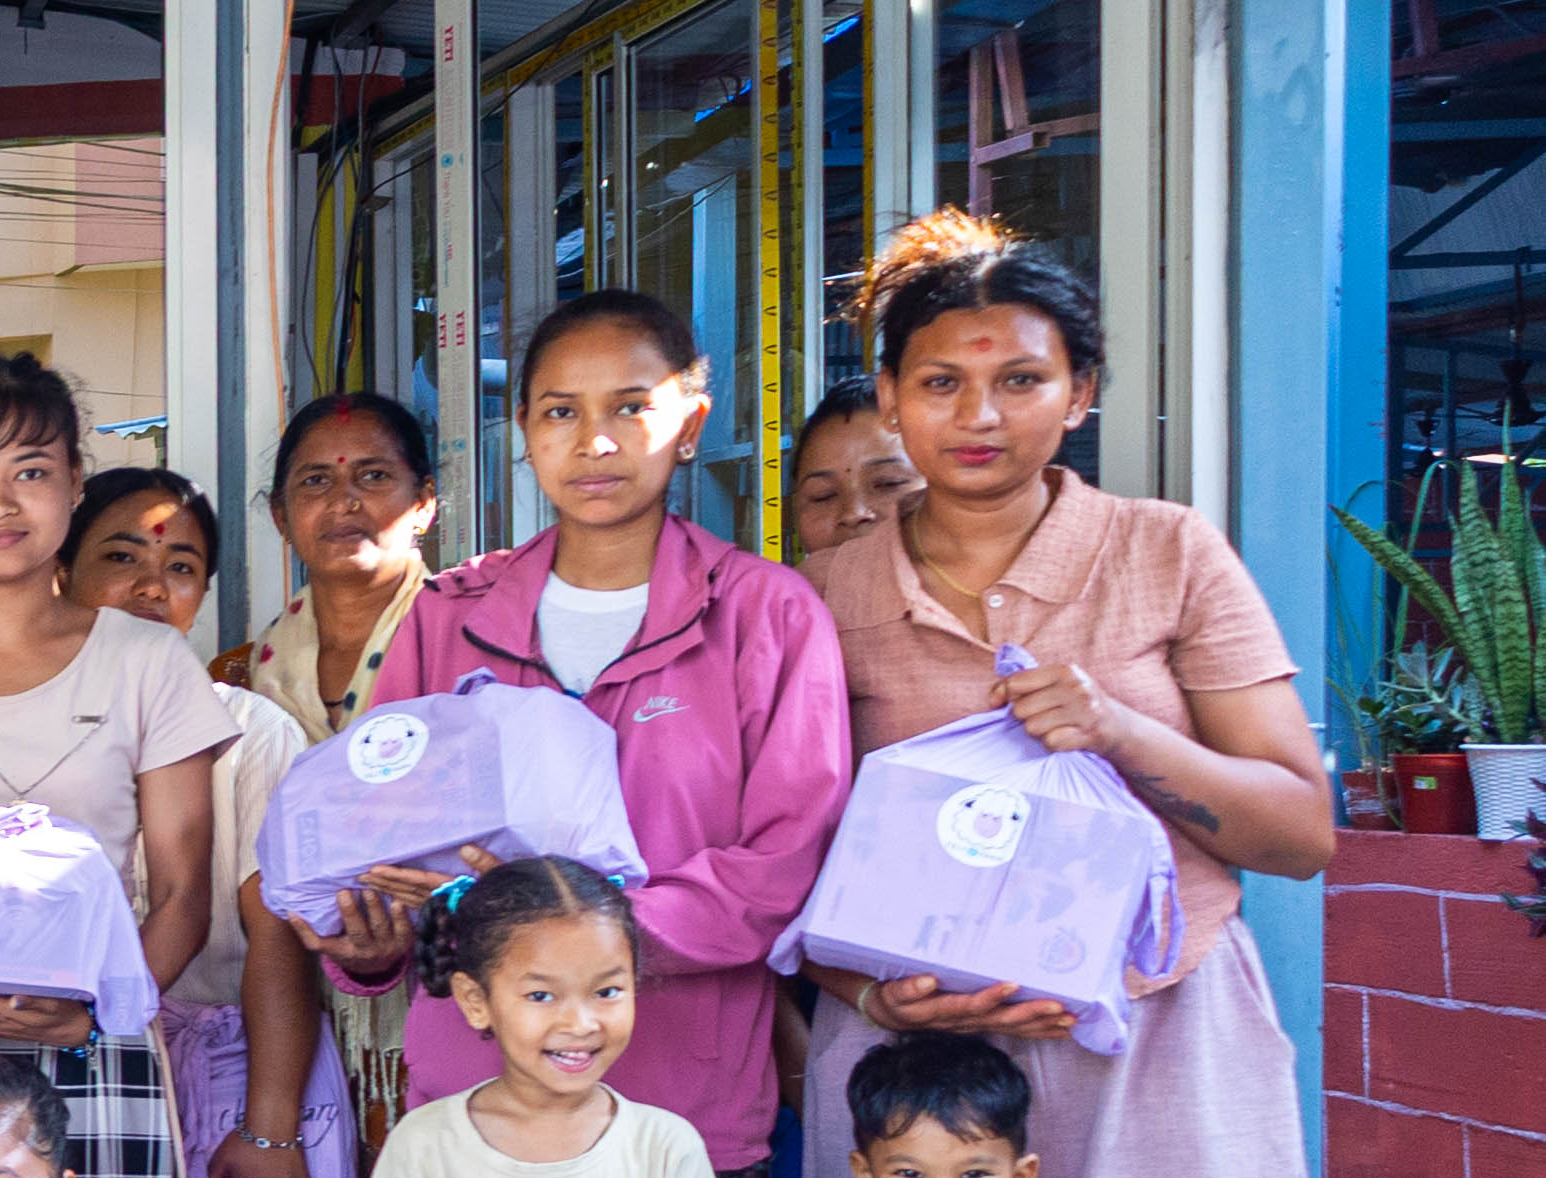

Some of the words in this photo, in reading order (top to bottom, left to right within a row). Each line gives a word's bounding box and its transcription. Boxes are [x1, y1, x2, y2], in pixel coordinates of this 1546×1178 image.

[444, 25, 453, 62] YETI
[456, 311, 465, 346] YETI
[644, 696, 679, 710] NIKE
